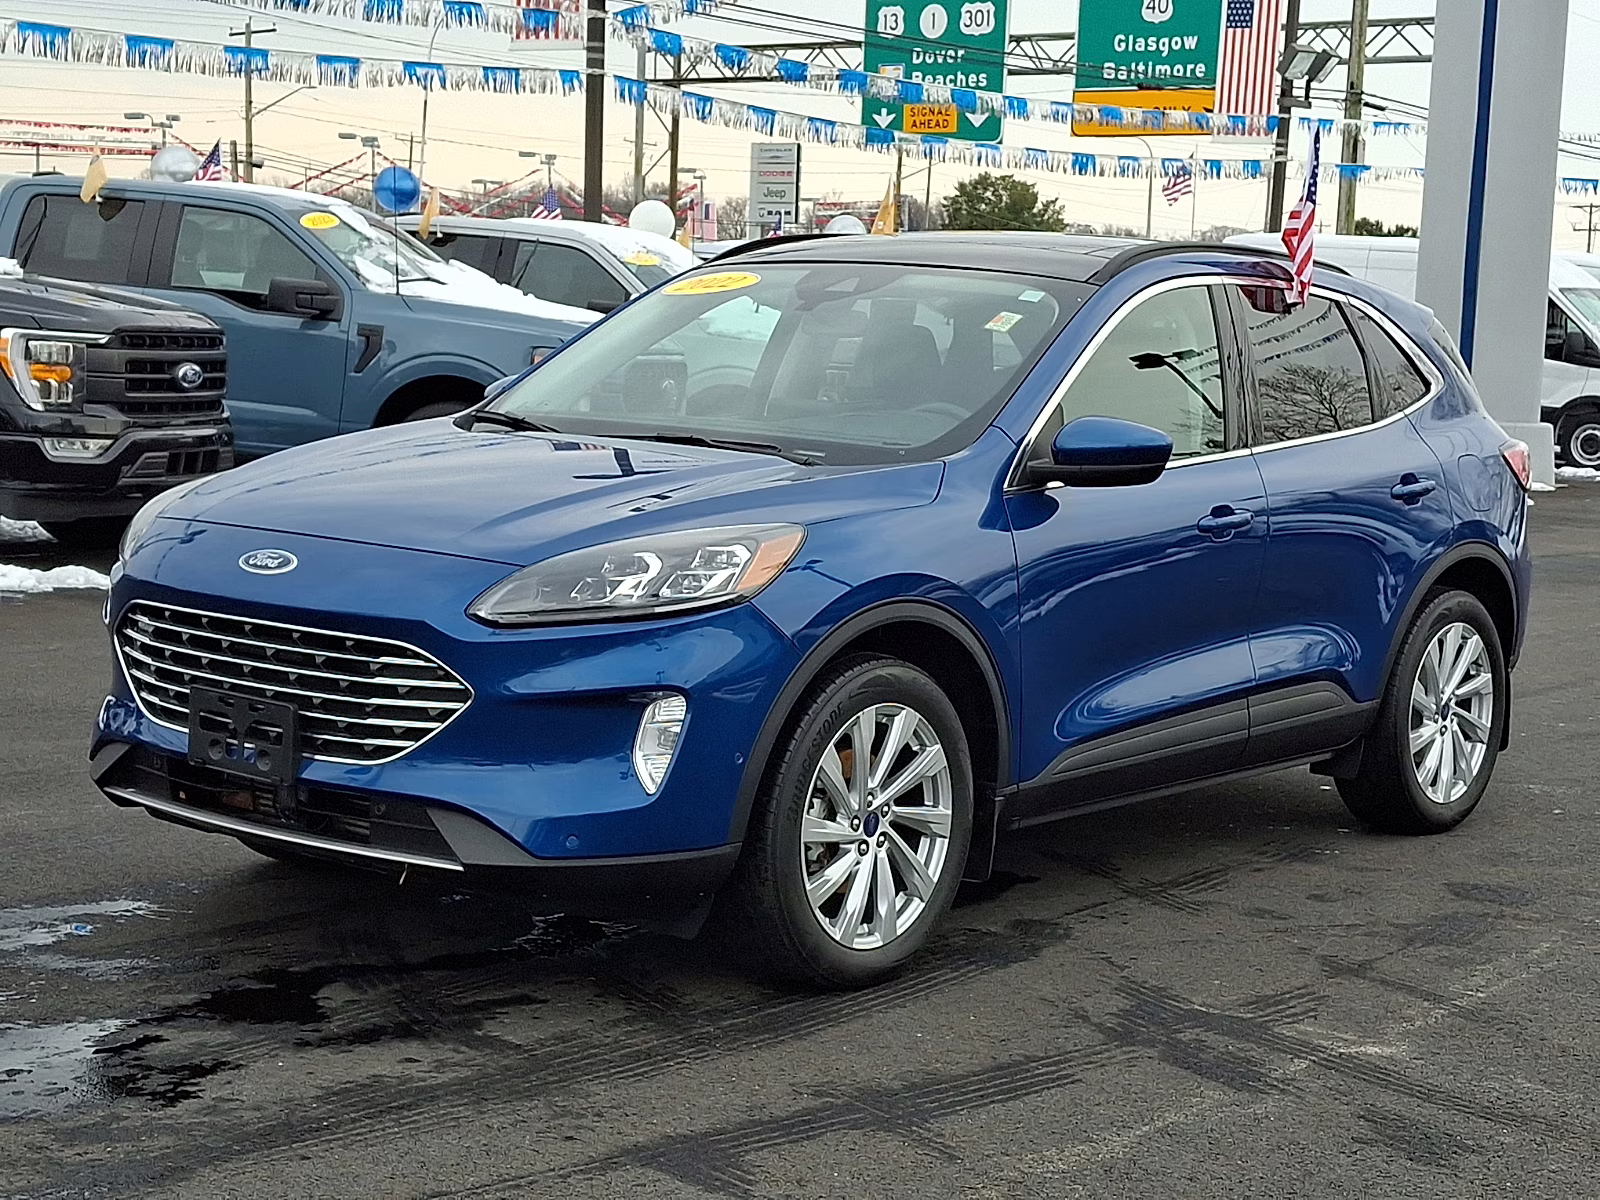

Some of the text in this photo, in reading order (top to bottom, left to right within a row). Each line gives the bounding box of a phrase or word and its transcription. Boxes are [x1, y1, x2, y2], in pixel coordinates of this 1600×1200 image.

[1145, 0, 1169, 14] 40
[883, 9, 991, 31] 13 1 301
[1113, 33, 1199, 58] Glasgow
[911, 47, 965, 65] Dover
[911, 69, 988, 88] Beaches
[1102, 60, 1206, 80] Baltimore
[909, 106, 951, 118] SIGNAL
[911, 118, 950, 129] AHEAD
[763, 186, 786, 200] Jeep
[248, 551, 284, 568] Ford
